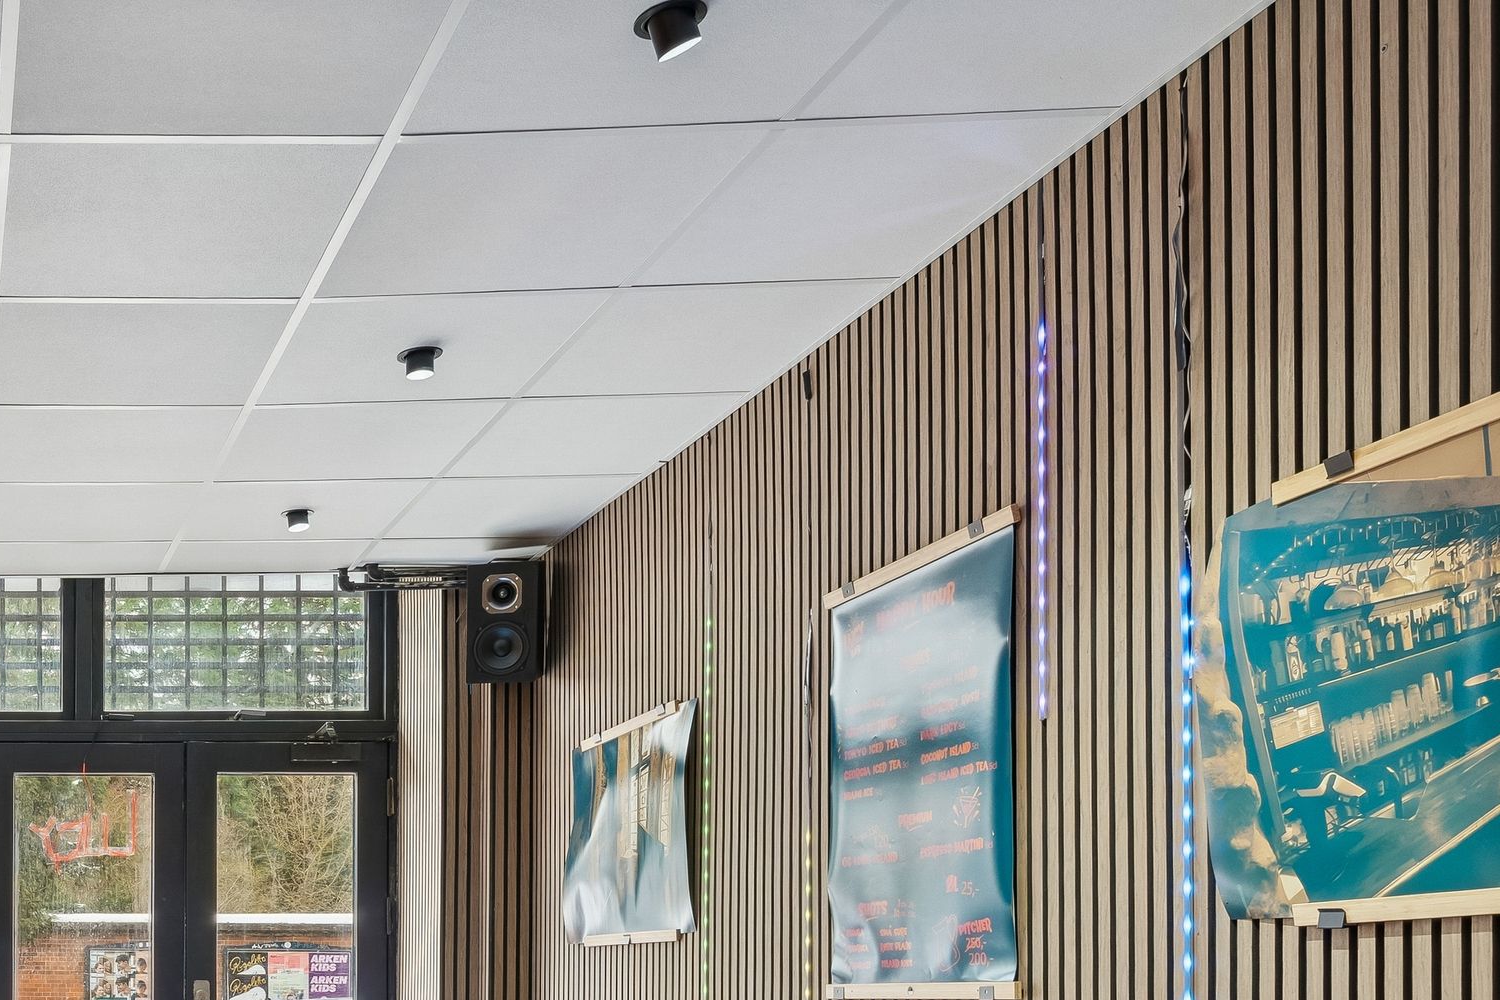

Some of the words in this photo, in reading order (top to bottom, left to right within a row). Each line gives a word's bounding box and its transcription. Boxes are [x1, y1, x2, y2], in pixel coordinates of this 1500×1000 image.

[868, 742, 885, 755] ICED
[886, 738, 899, 750] TEA
[920, 747, 948, 765] COCONUT
[949, 741, 971, 756] ISLAND
[872, 763, 888, 775] ICED
[889, 759, 901, 771] TEA
[938, 768, 959, 780] ISLAND
[960, 764, 974, 776] ICED
[976, 760, 988, 772] TEA
[858, 900, 889, 916] SHOTS
[958, 917, 993, 935] PITCHER
[310, 954, 347, 963] ARKEN
[969, 952, 995, 967] 200,-
[311, 963, 337, 972] KIDS
[310, 975, 347, 984] ARKEN
[311, 984, 337, 993] KIDS
